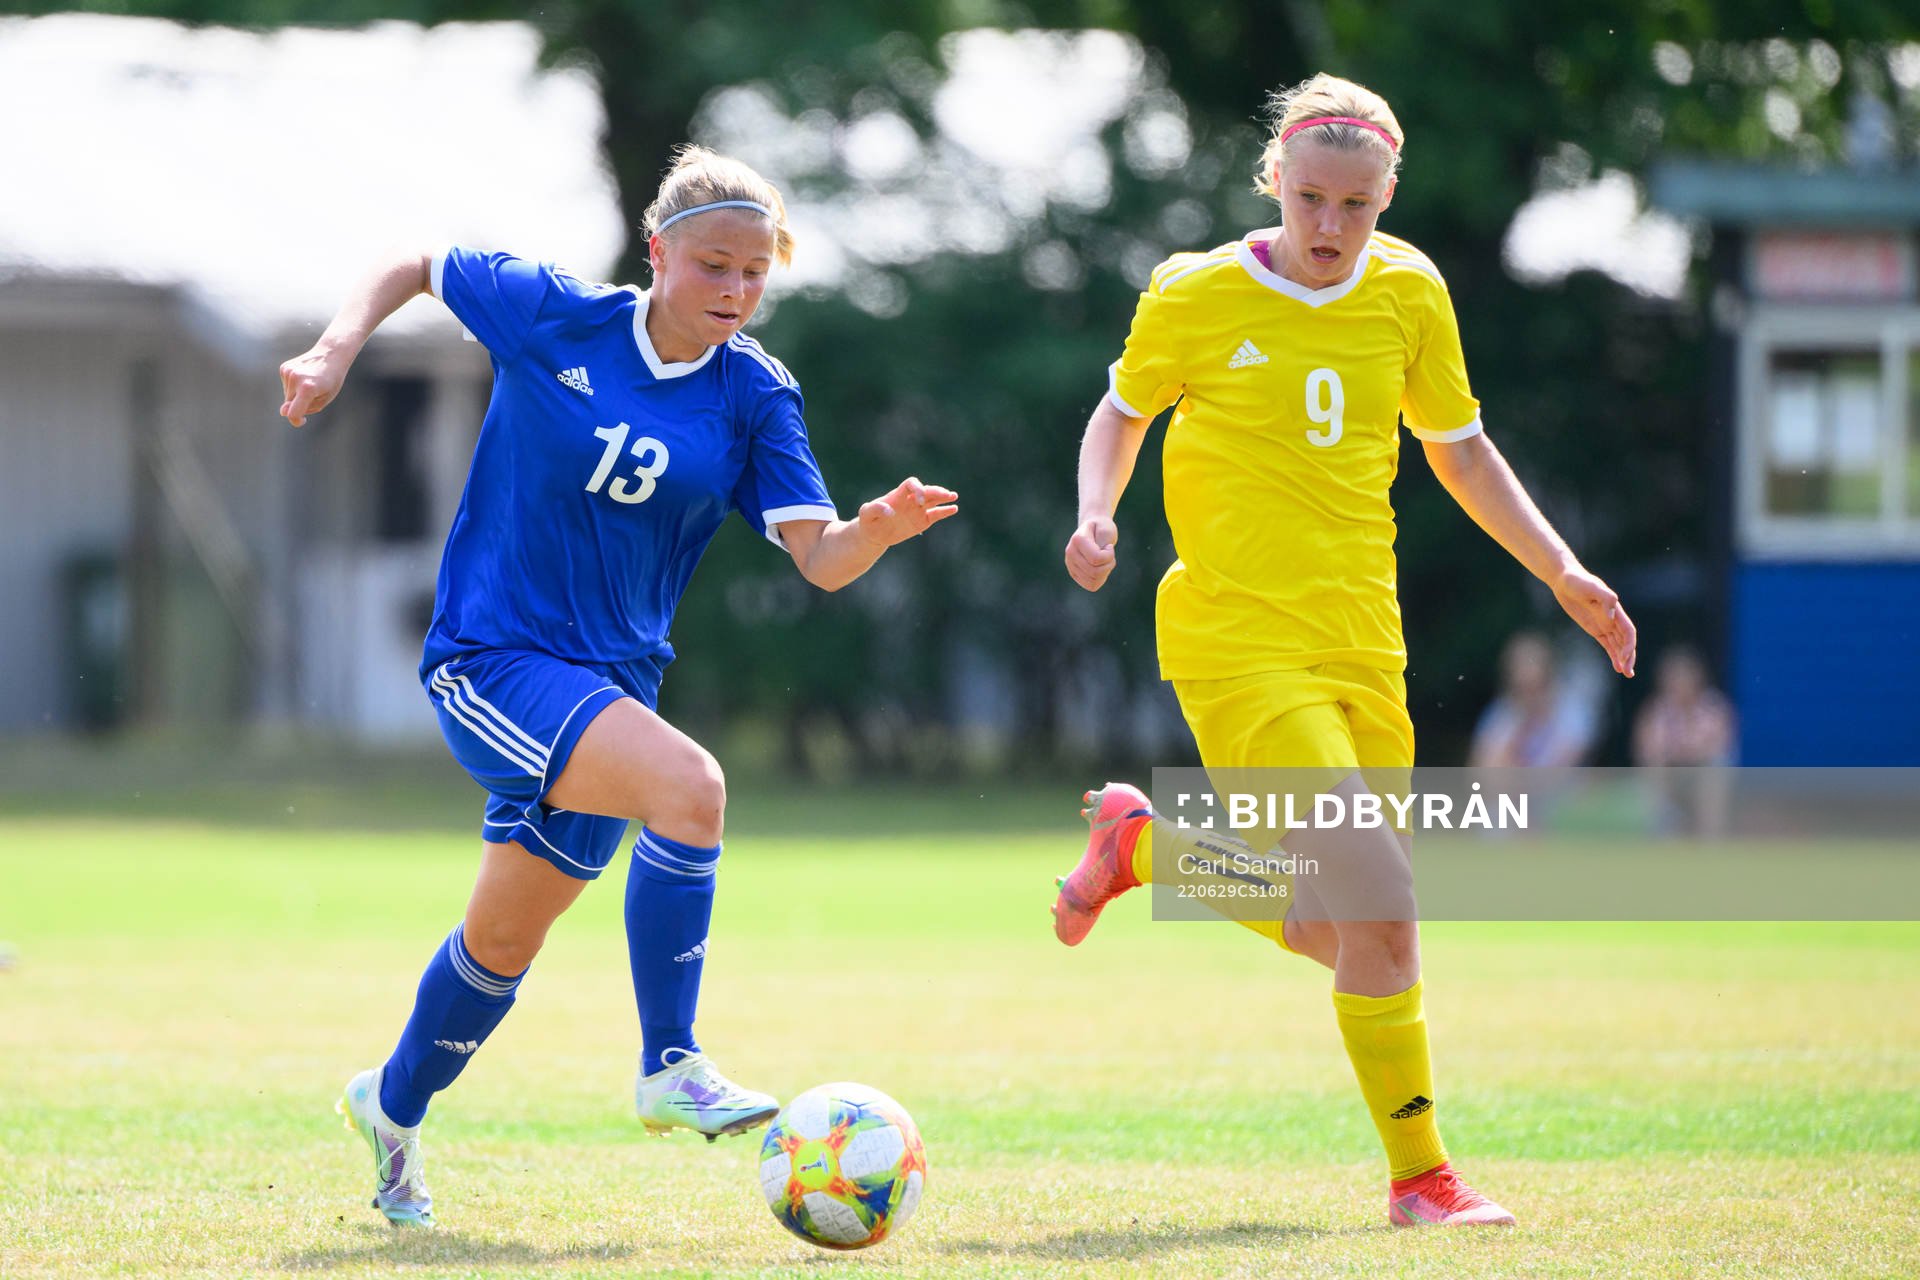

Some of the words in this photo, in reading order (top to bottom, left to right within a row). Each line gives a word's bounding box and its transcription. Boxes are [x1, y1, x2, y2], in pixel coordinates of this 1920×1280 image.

[556, 373, 594, 396] adidas
[1228, 354, 1269, 369] adidas
[1305, 367, 1345, 448] 9
[584, 421, 670, 505] 13
